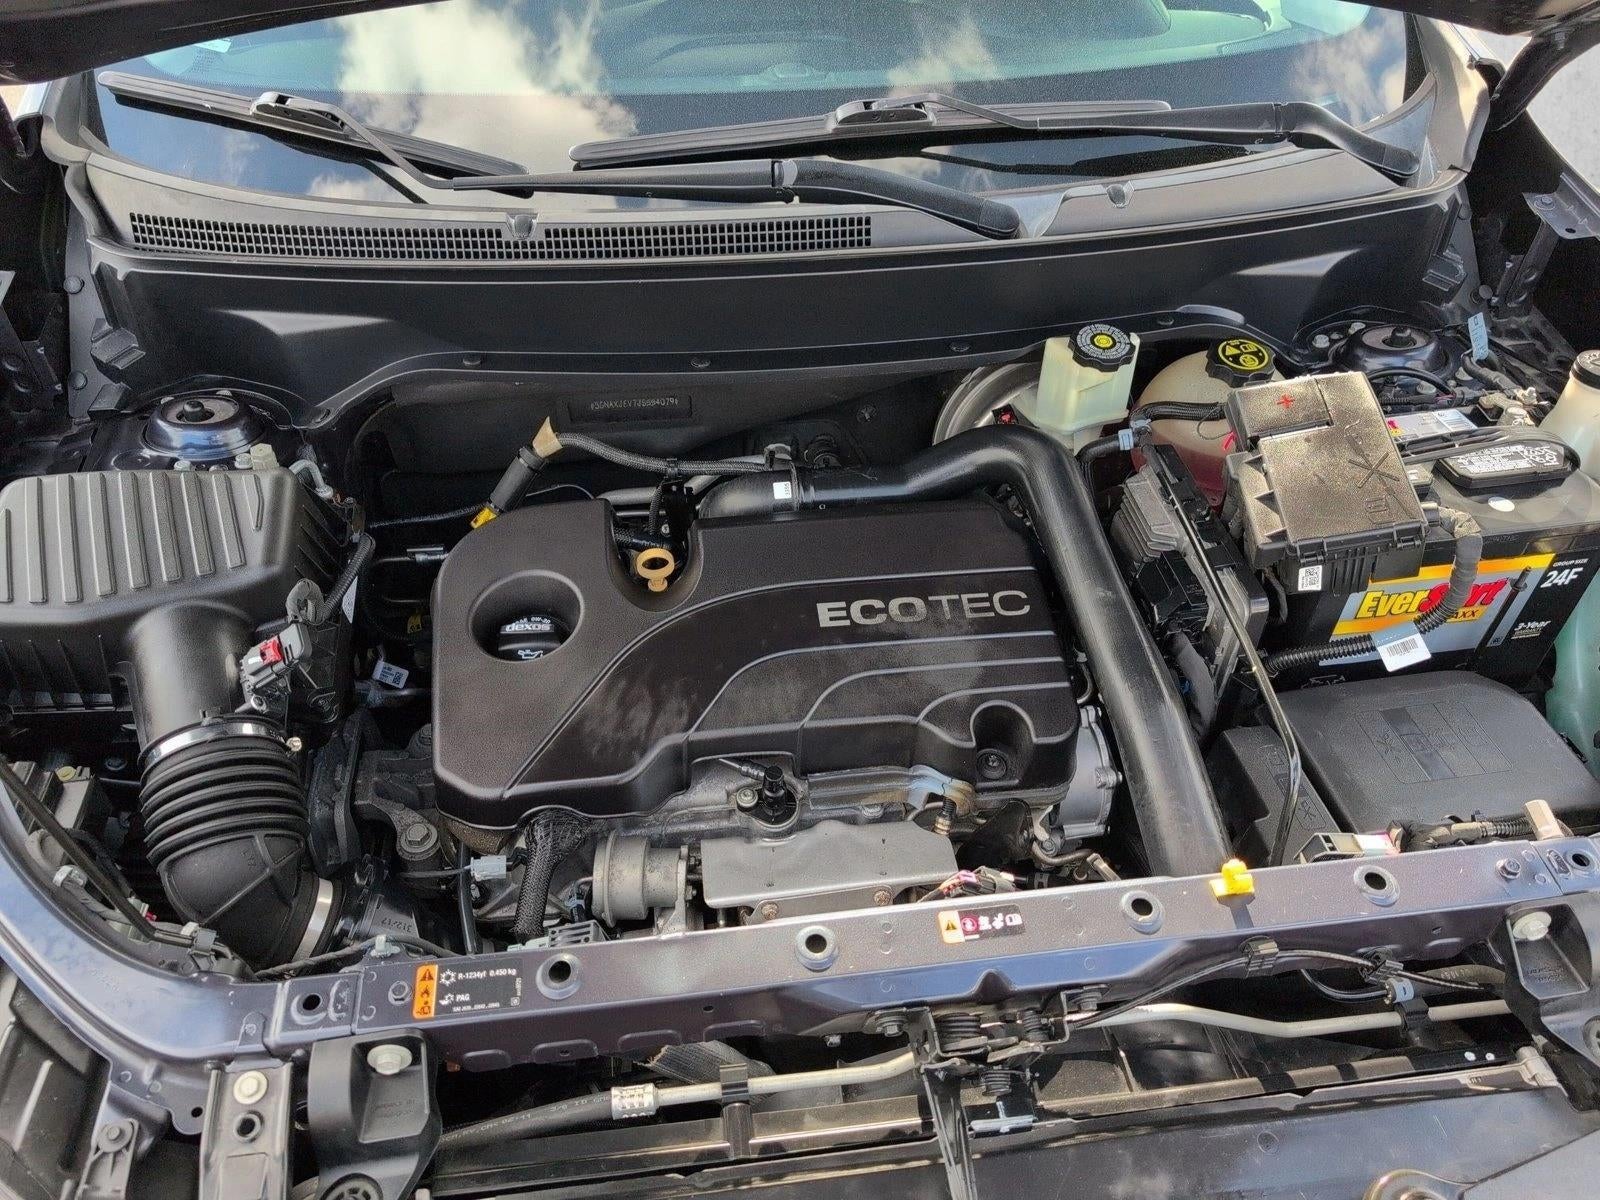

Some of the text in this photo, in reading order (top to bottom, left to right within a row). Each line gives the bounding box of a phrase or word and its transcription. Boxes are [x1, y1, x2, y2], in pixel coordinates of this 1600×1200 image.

[1540, 567, 1584, 589] 24F
[816, 590, 1031, 628] ECOTEC
[506, 623, 551, 632] dexos
[1514, 620, 1552, 631] 3-Year
[458, 970, 487, 980] R-1234yf
[508, 968, 517, 976] kg
[456, 993, 470, 1002] PAG
